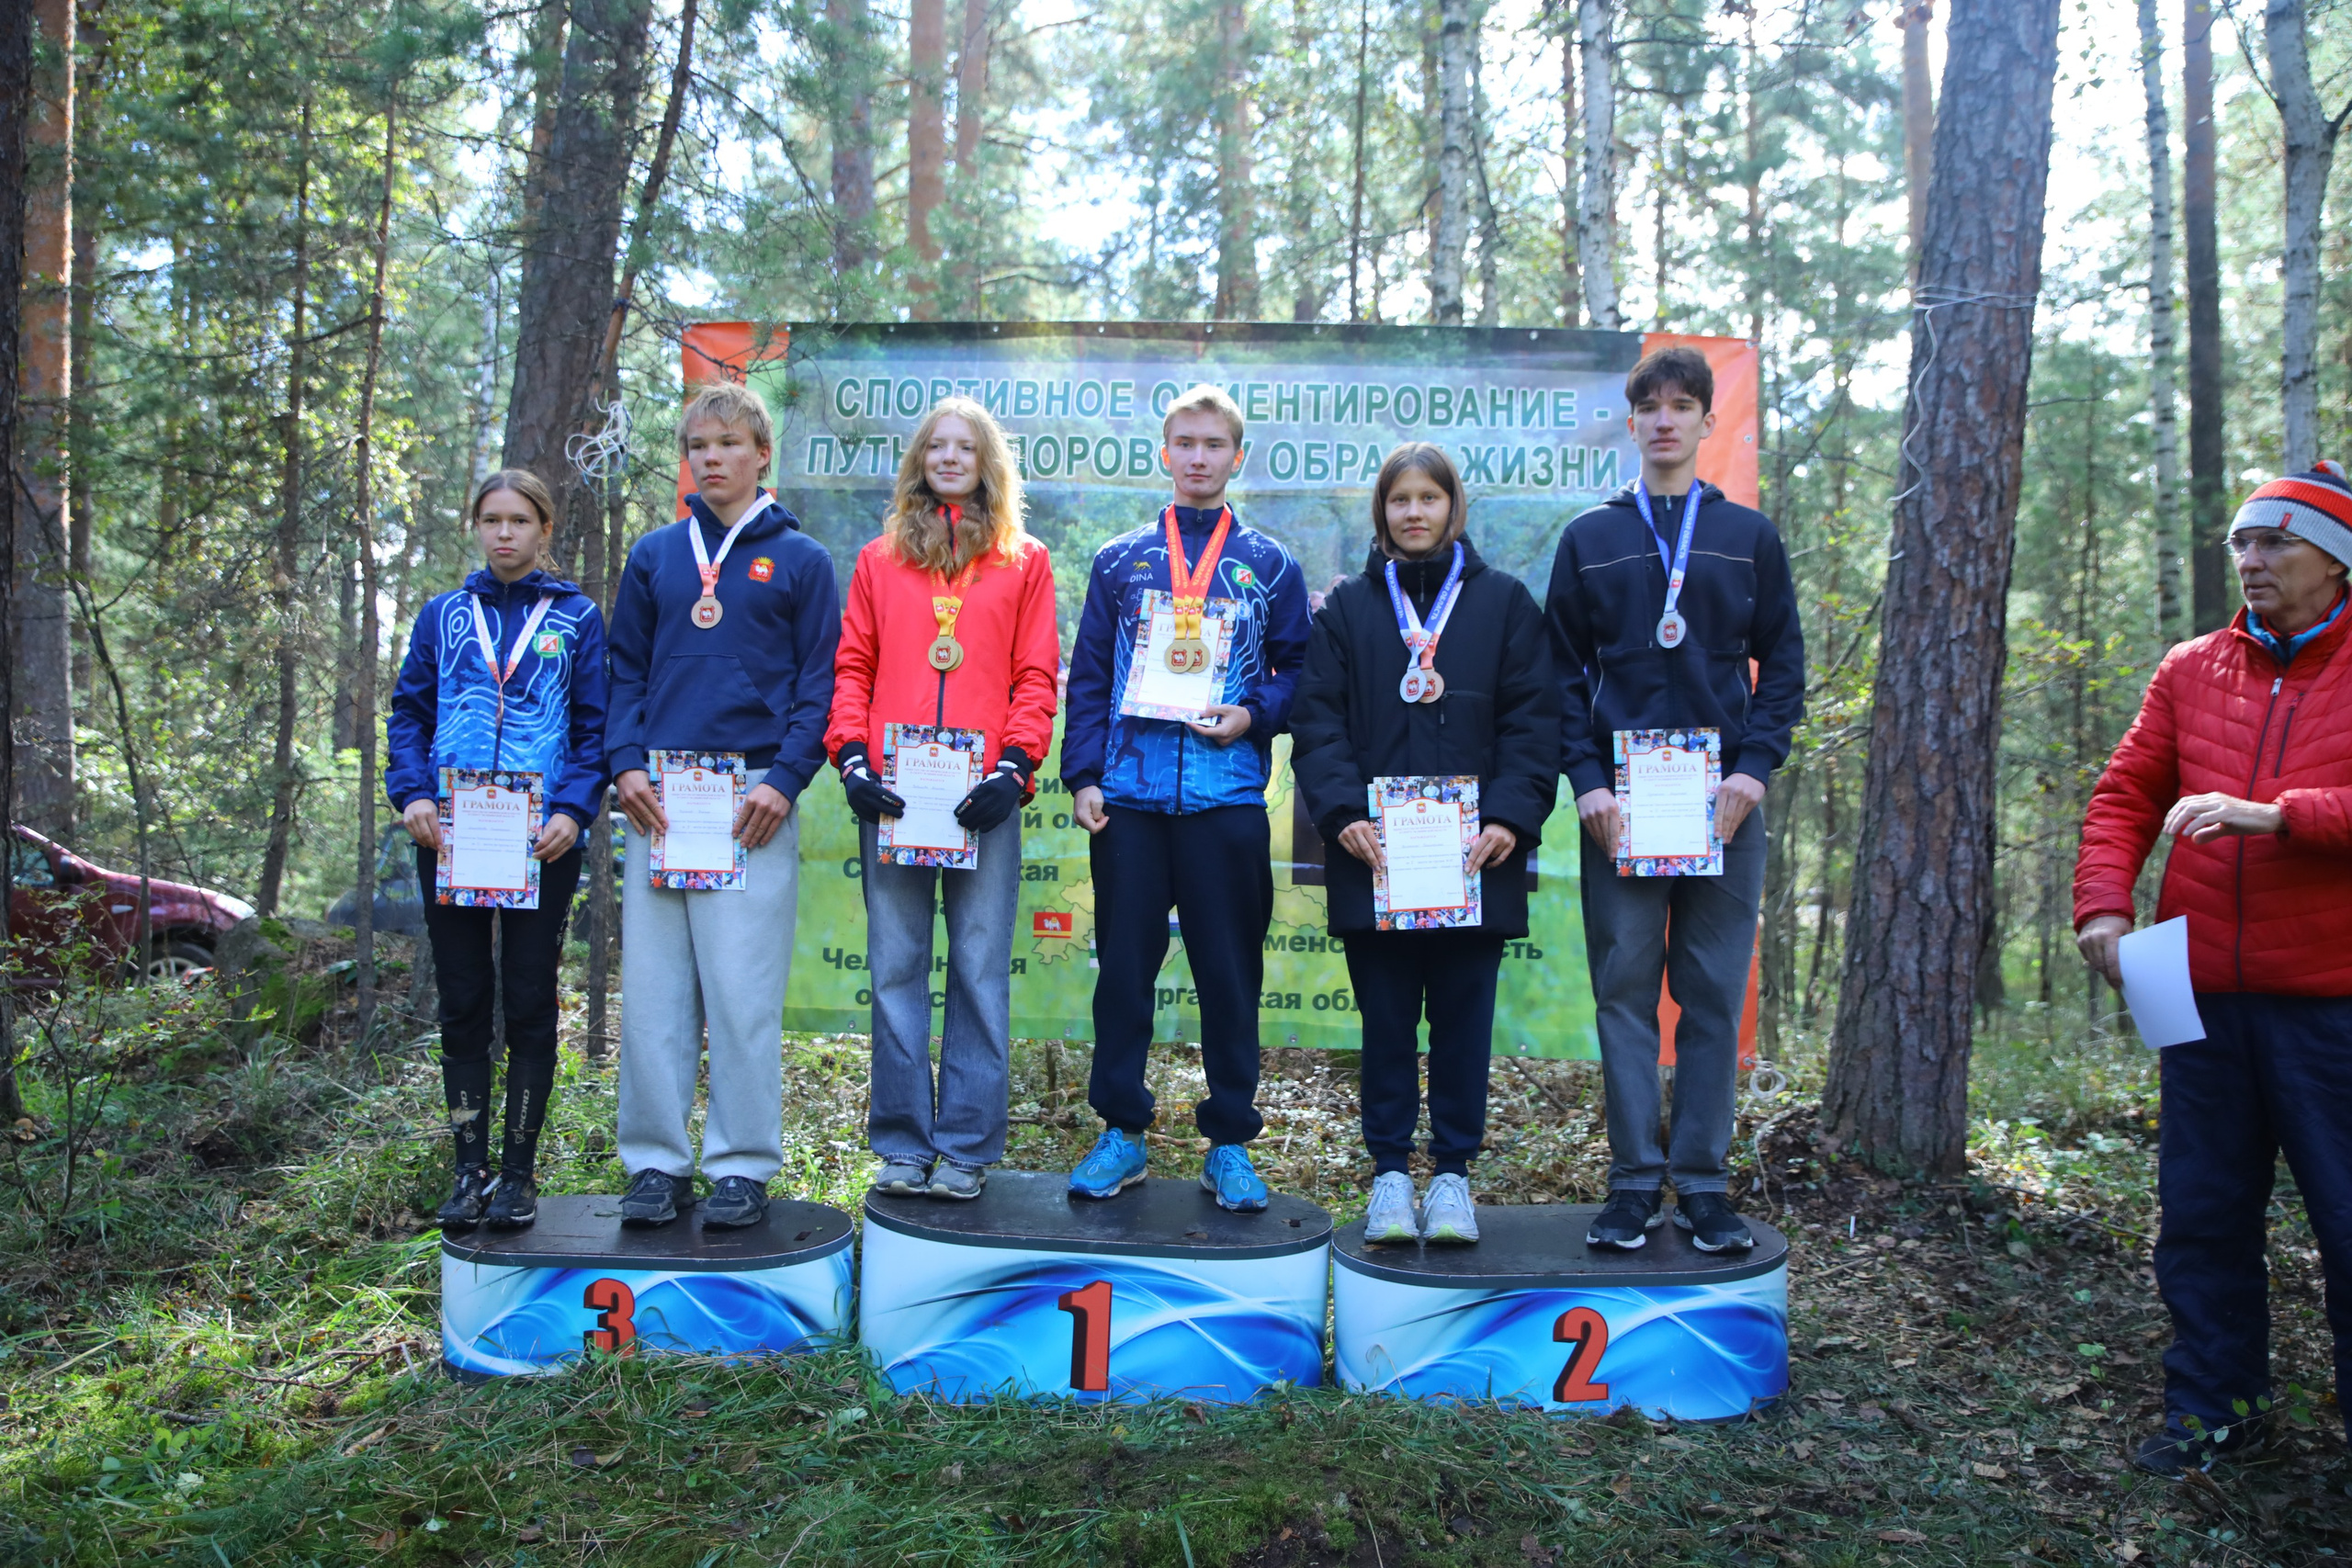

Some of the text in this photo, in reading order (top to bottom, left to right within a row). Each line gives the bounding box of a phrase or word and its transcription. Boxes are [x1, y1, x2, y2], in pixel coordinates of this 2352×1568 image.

[833, 377, 1135, 420] СПОРТИВНОЕ
[1150, 380, 1578, 429] ОЕНТИРОВАНИЕ
[1268, 440, 1443, 484] ОБРА
[1459, 445, 1620, 491] ЖИЗНИ
[1129, 572, 1154, 583] DINA
[905, 758, 961, 771] ГРАМОТА
[1638, 763, 1697, 774] ГРАМОТА
[672, 784, 726, 793] ГРАМОТА
[462, 799, 521, 812] ГРАМОТА
[1393, 815, 1452, 827] ГРАМОТА
[518, 1089, 530, 1131] NORD
[583, 1278, 636, 1358] 3
[1058, 1280, 1113, 1391] 1
[1553, 1306, 1609, 1403] 2
